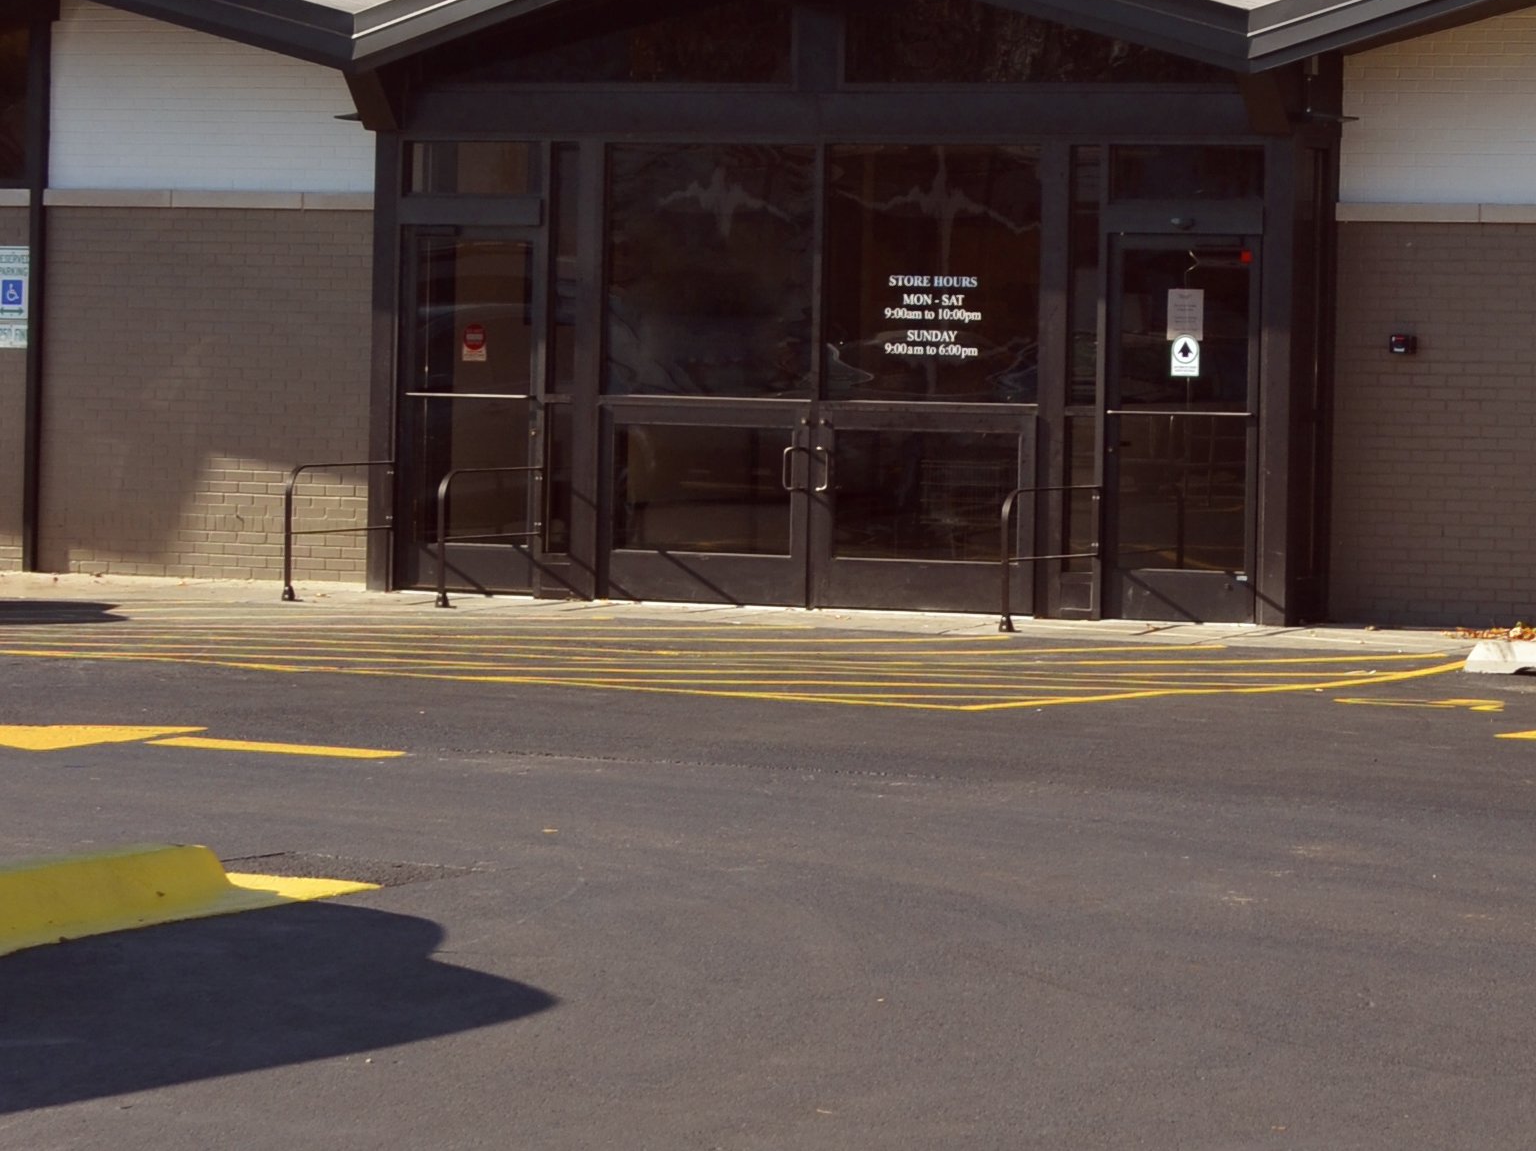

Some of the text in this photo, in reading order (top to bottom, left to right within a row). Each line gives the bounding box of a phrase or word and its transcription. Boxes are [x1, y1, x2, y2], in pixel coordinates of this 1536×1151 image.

[889, 275, 978, 288] STORE HOURS
[903, 294, 932, 305] MON
[941, 295, 965, 306] SAT
[884, 308, 982, 323] 9:00am to 10:00pm
[907, 330, 957, 342] SUNDAY
[884, 343, 978, 358] 9:00am to 6:00pm
